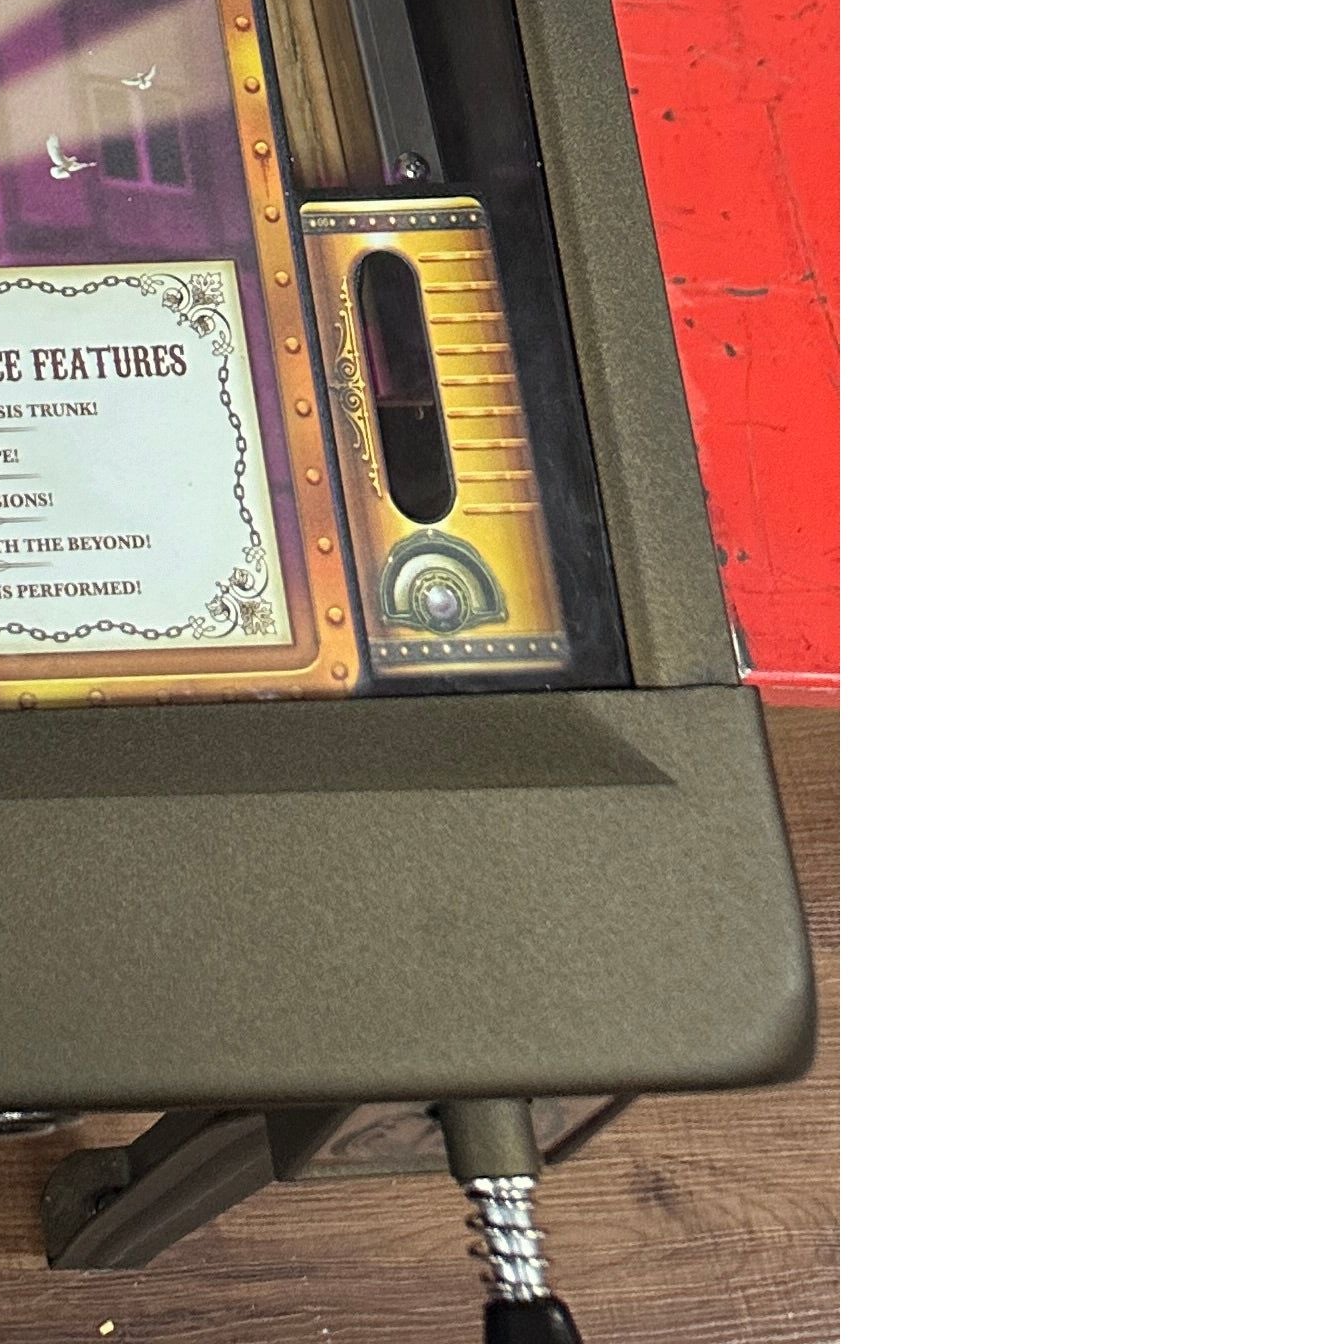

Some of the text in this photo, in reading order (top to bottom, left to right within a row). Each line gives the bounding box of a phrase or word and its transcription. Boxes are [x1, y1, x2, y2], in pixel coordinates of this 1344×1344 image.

[30, 344, 187, 381] FEATURES
[26, 402, 98, 418] TRUNK!
[22, 537, 64, 553] THE
[67, 534, 151, 551] BEYOND!
[16, 580, 142, 599] PERFORMED!
